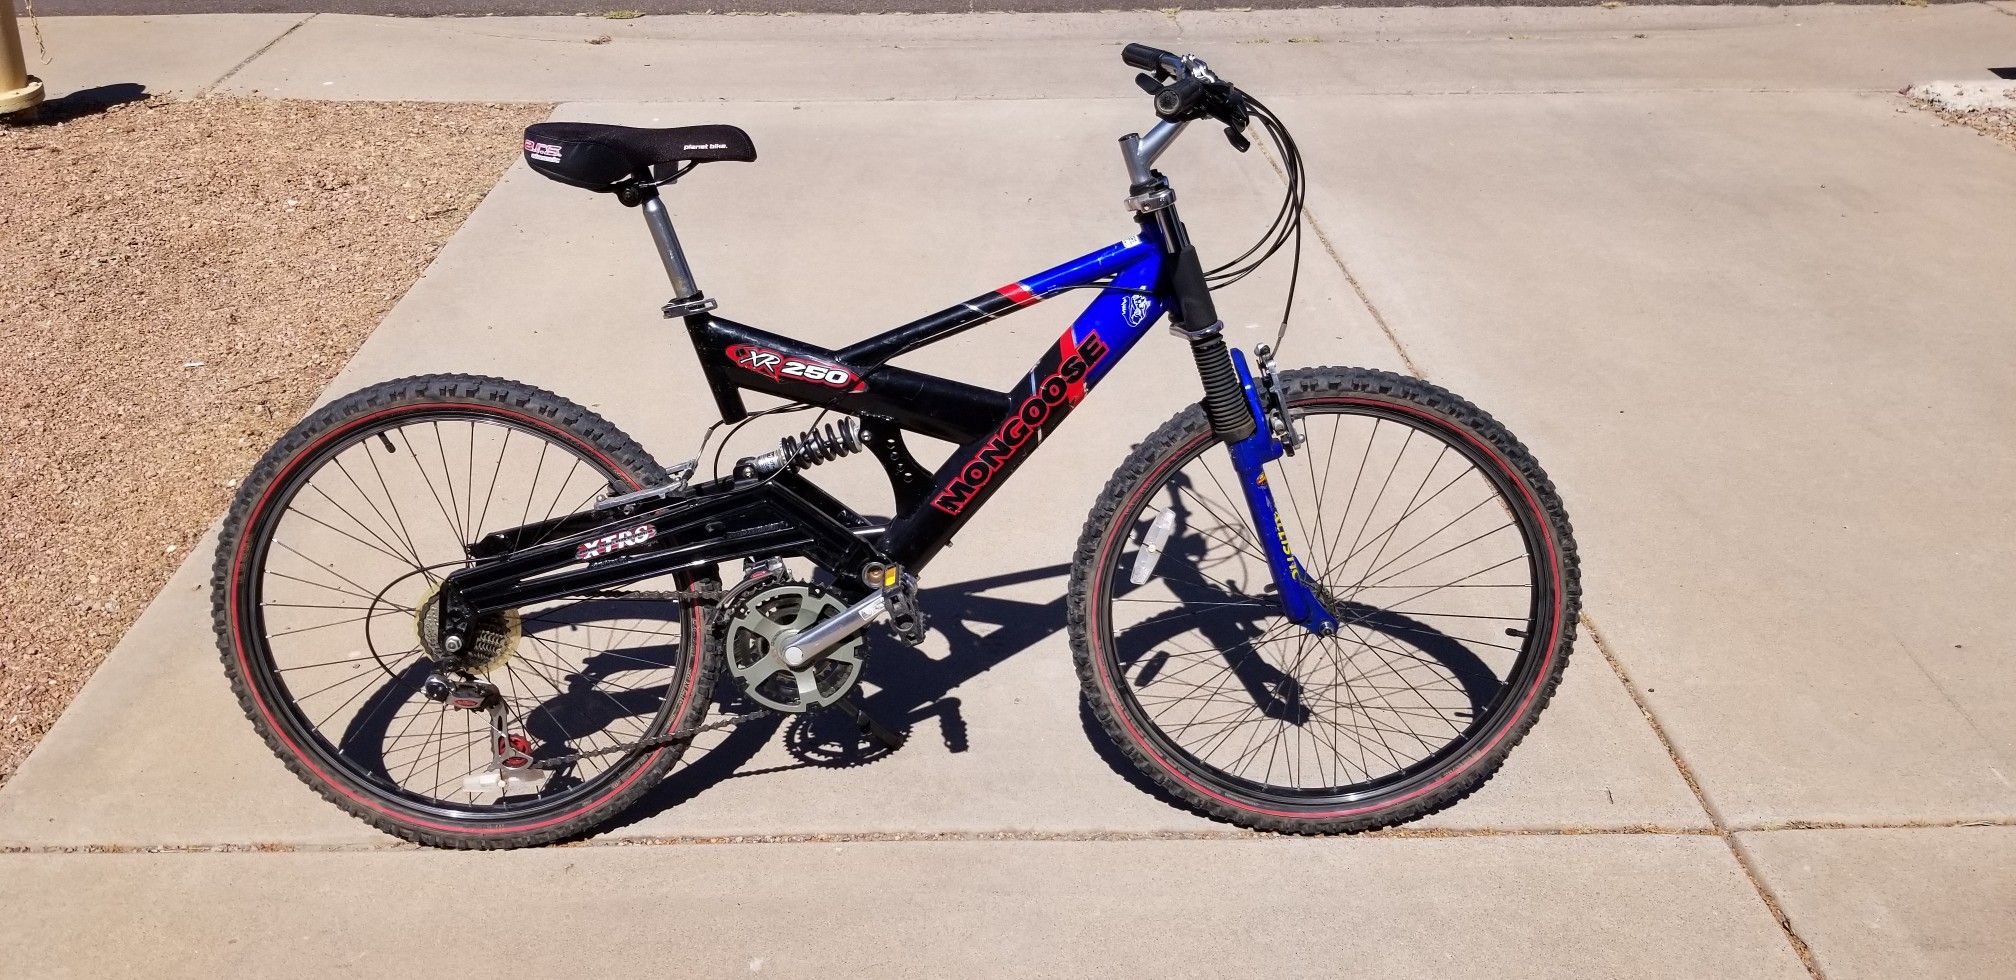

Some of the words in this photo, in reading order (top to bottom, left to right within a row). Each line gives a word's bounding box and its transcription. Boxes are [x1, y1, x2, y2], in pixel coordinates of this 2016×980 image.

[683, 143, 709, 151] planet
[740, 350, 781, 373] XR
[781, 361, 849, 384] 250
[931, 329, 1109, 515] MONGOOSE
